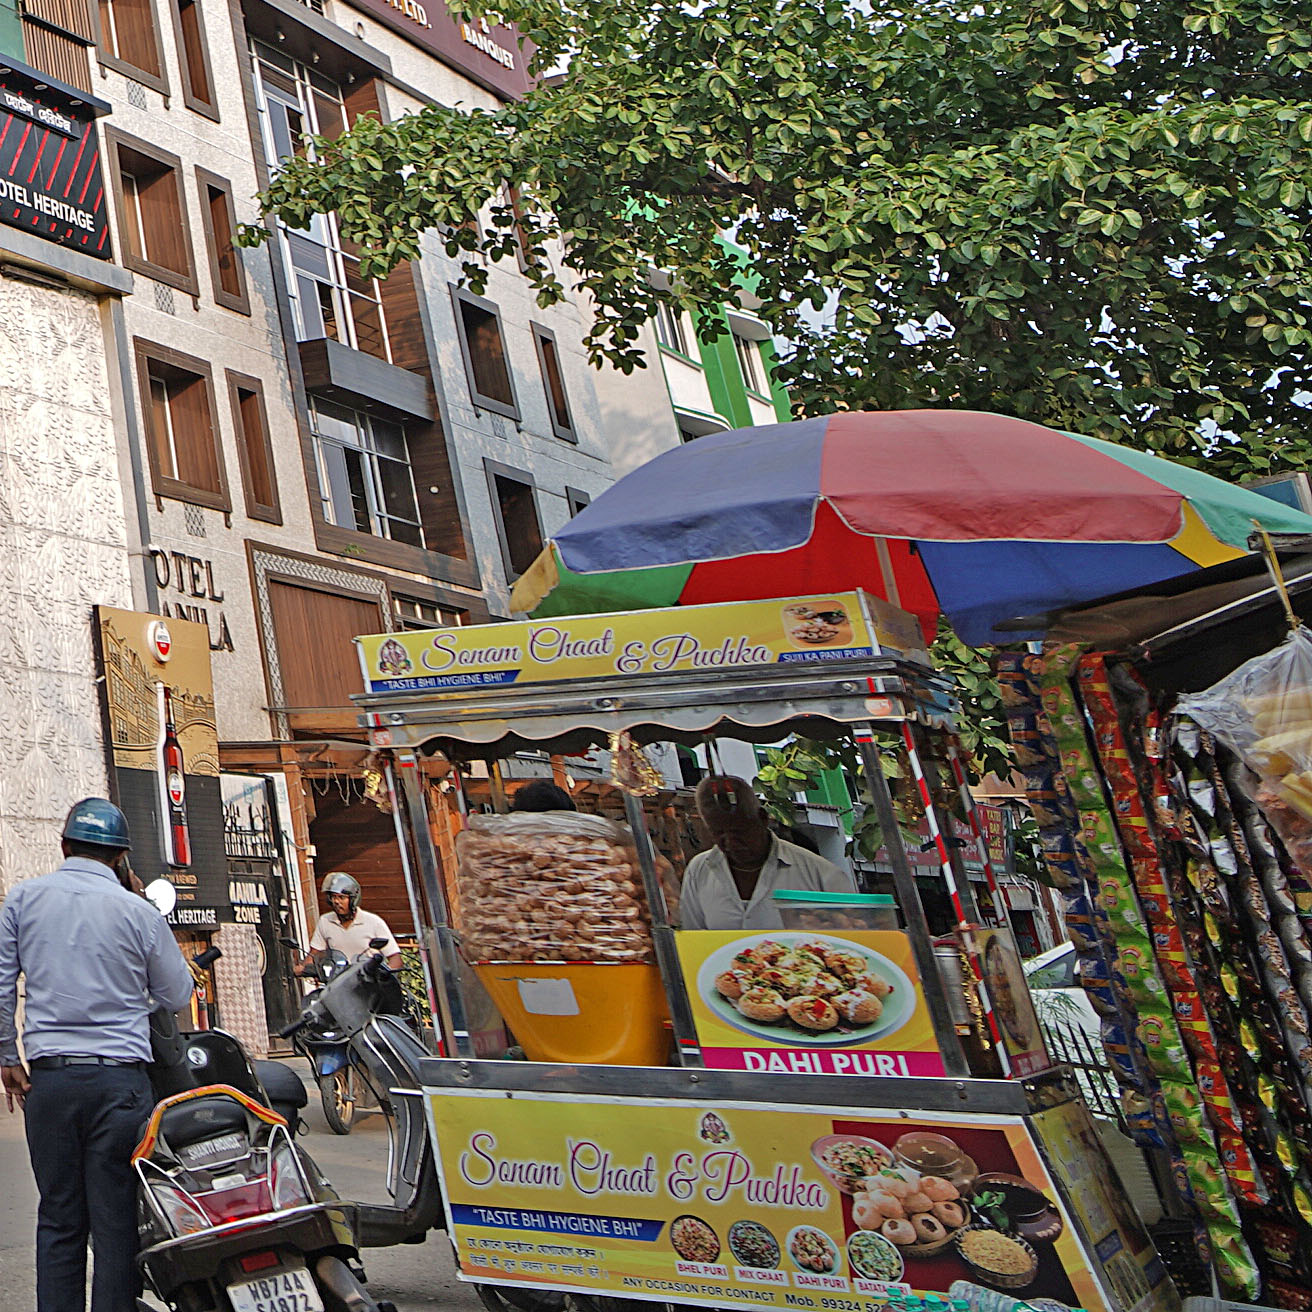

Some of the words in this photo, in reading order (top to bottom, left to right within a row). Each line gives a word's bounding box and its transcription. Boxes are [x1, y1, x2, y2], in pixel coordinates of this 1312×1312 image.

[461, 23, 515, 70] BANQUET
[33, 190, 97, 233] HERITAGE
[154, 548, 225, 604] OTEL
[421, 633, 521, 671] Sonam
[527, 625, 616, 664] Chaat
[616, 642, 651, 673] &
[651, 633, 769, 672] Puchka
[418, 678, 436, 688] BHI
[437, 674, 482, 686] HYGIENE
[177, 908, 217, 926] HERITAGE
[233, 906, 262, 924] ZONE
[742, 1051, 822, 1074] DAHI
[826, 1053, 910, 1076] PURI
[461, 1133, 562, 1186] Sonam
[567, 1137, 656, 1195] Chaat
[667, 1152, 699, 1201] &
[702, 1150, 827, 1208] Puchka
[521, 1211, 547, 1230] BHI
[548, 1214, 613, 1236] HYGIENE
[677, 1263, 699, 1275] BHEL
[700, 1265, 727, 1277] PURI
[737, 1269, 755, 1280] MIX
[755, 1271, 785, 1283] CHAAT
[797, 1275, 822, 1286] DAHI
[823, 1277, 847, 1289] PURI
[622, 1277, 646, 1289] ANY
[645, 1278, 699, 1295] OCCASION
[701, 1286, 725, 1297] FOR
[725, 1288, 776, 1303] CONTACT
[785, 1294, 819, 1309] Mob.
[821, 1297, 861, 1312] 99324
